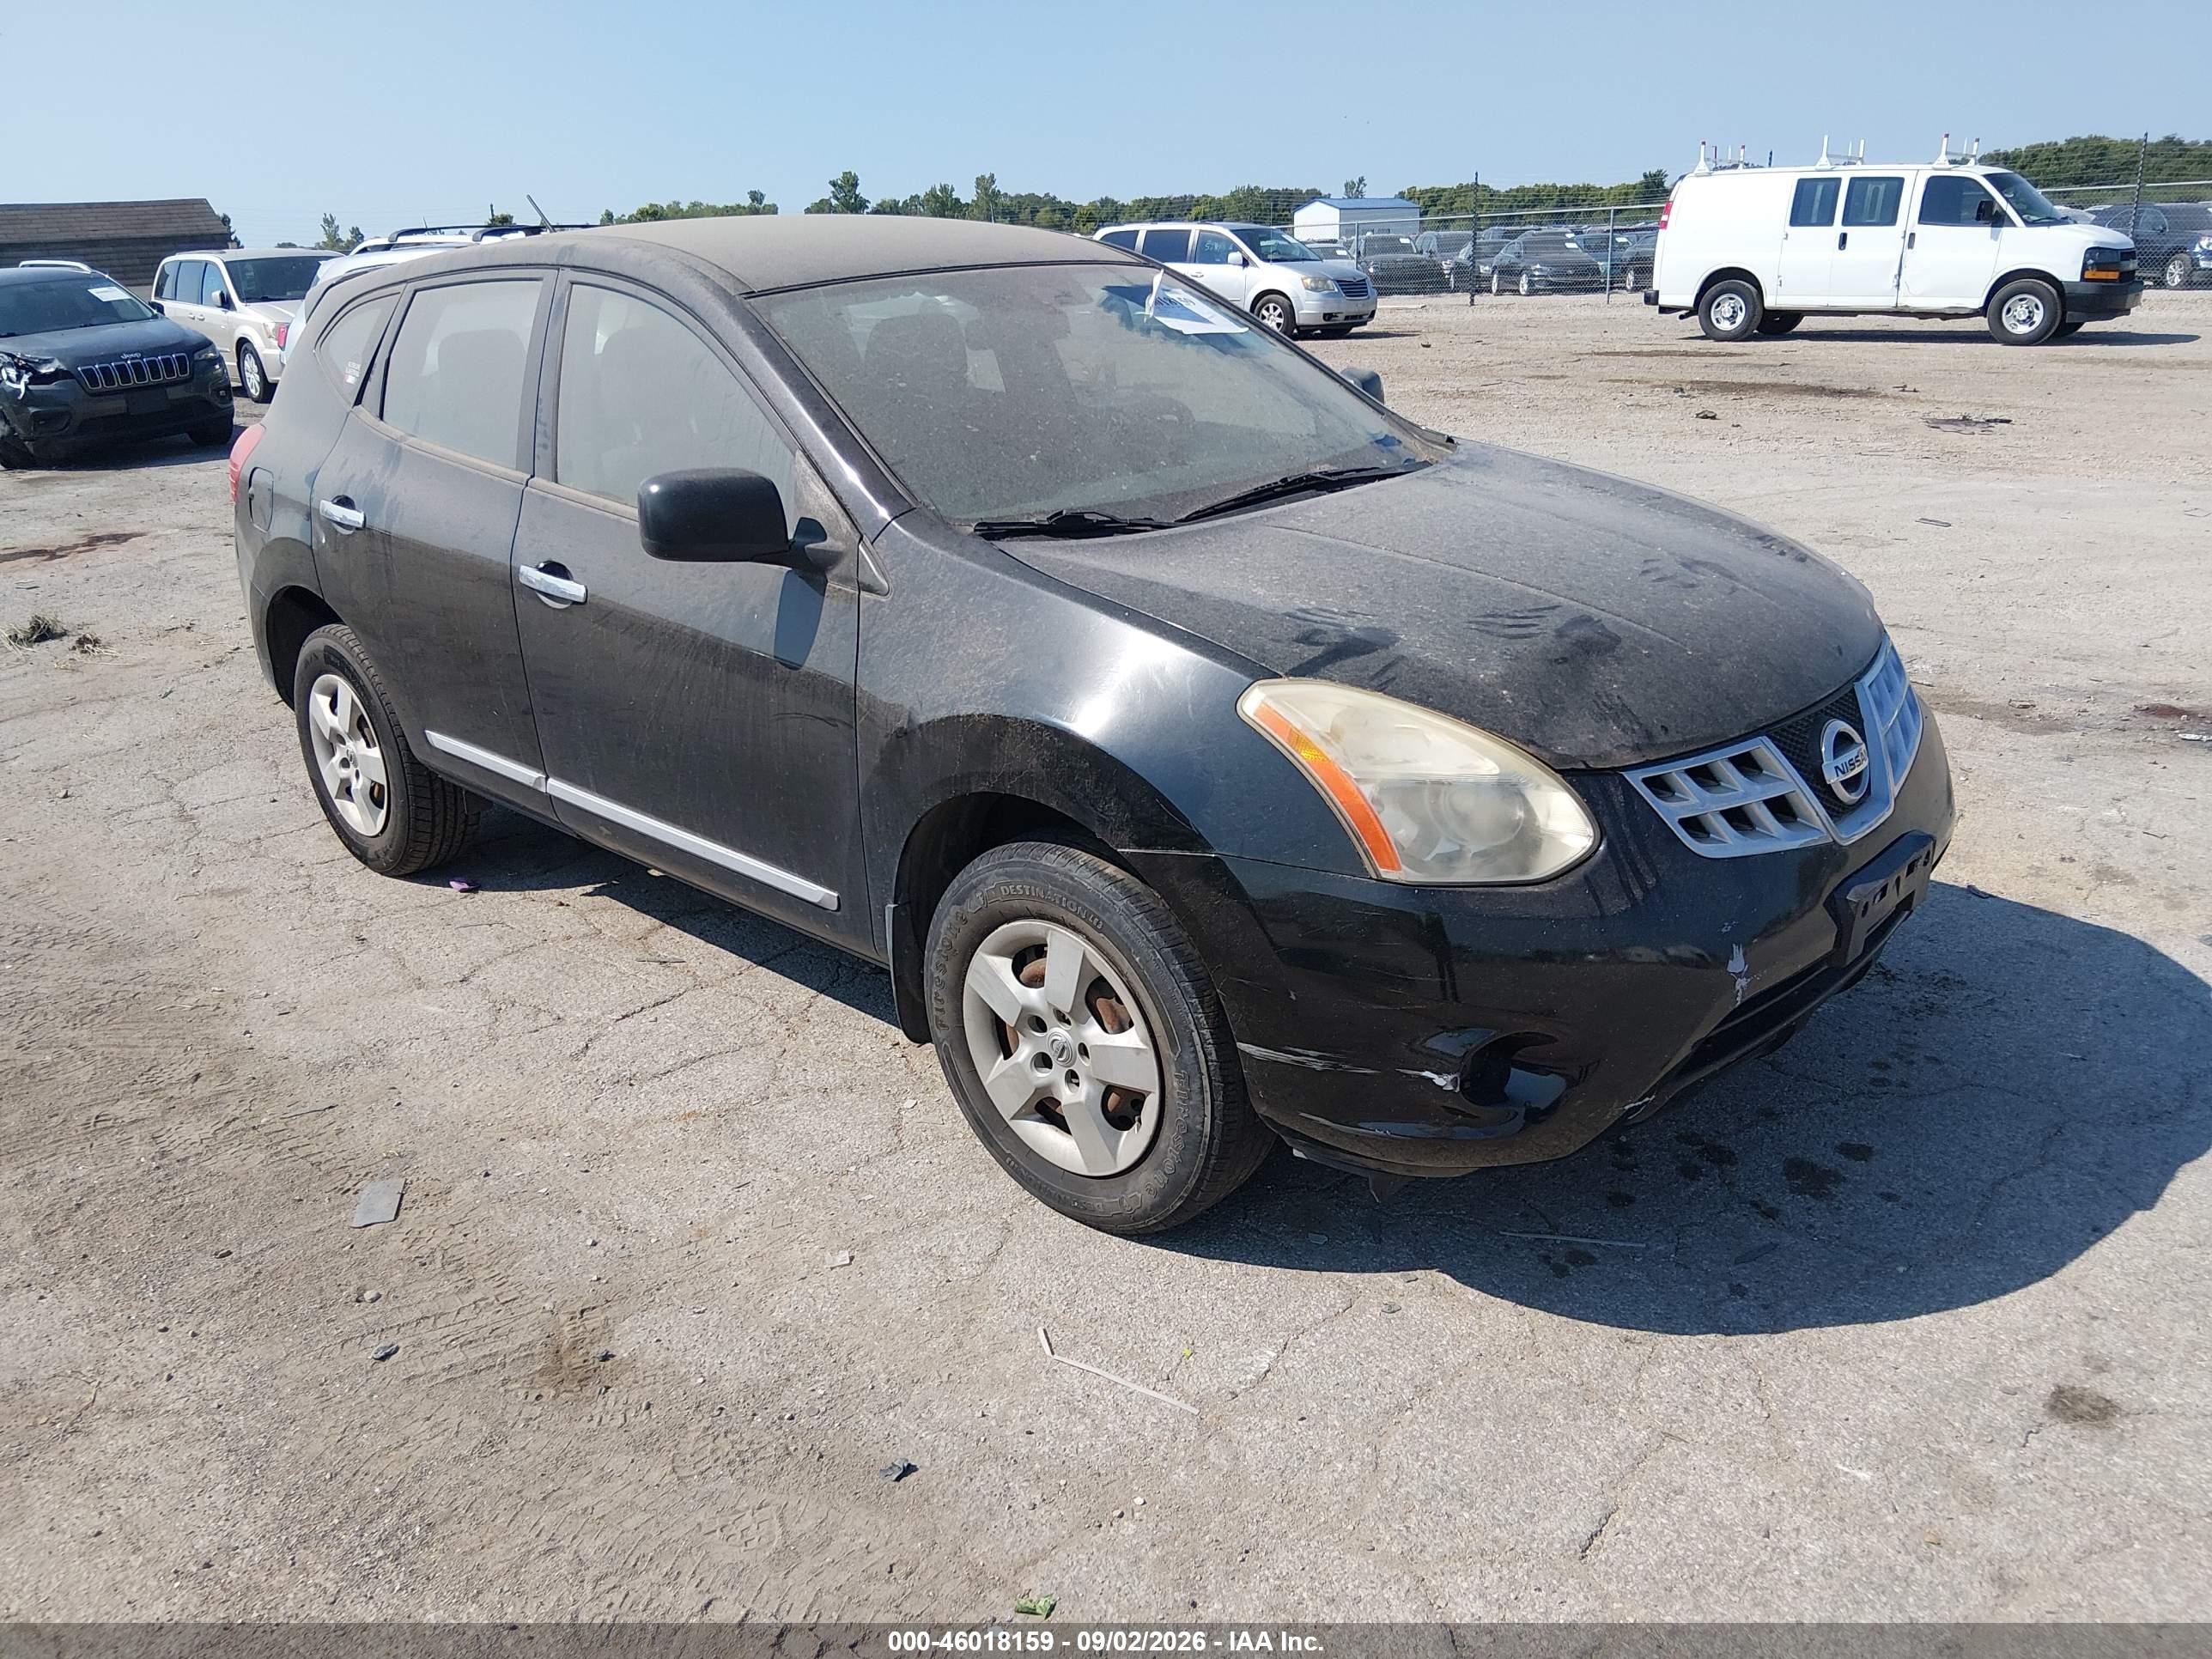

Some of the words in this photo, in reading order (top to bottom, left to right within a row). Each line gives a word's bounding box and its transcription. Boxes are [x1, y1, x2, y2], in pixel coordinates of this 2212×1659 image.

[1834, 748, 1868, 777] NISSAN
[1000, 884, 1087, 921] DESTINATION
[934, 910, 969, 1031] Firestone
[1144, 1070, 1191, 1199] Firestone
